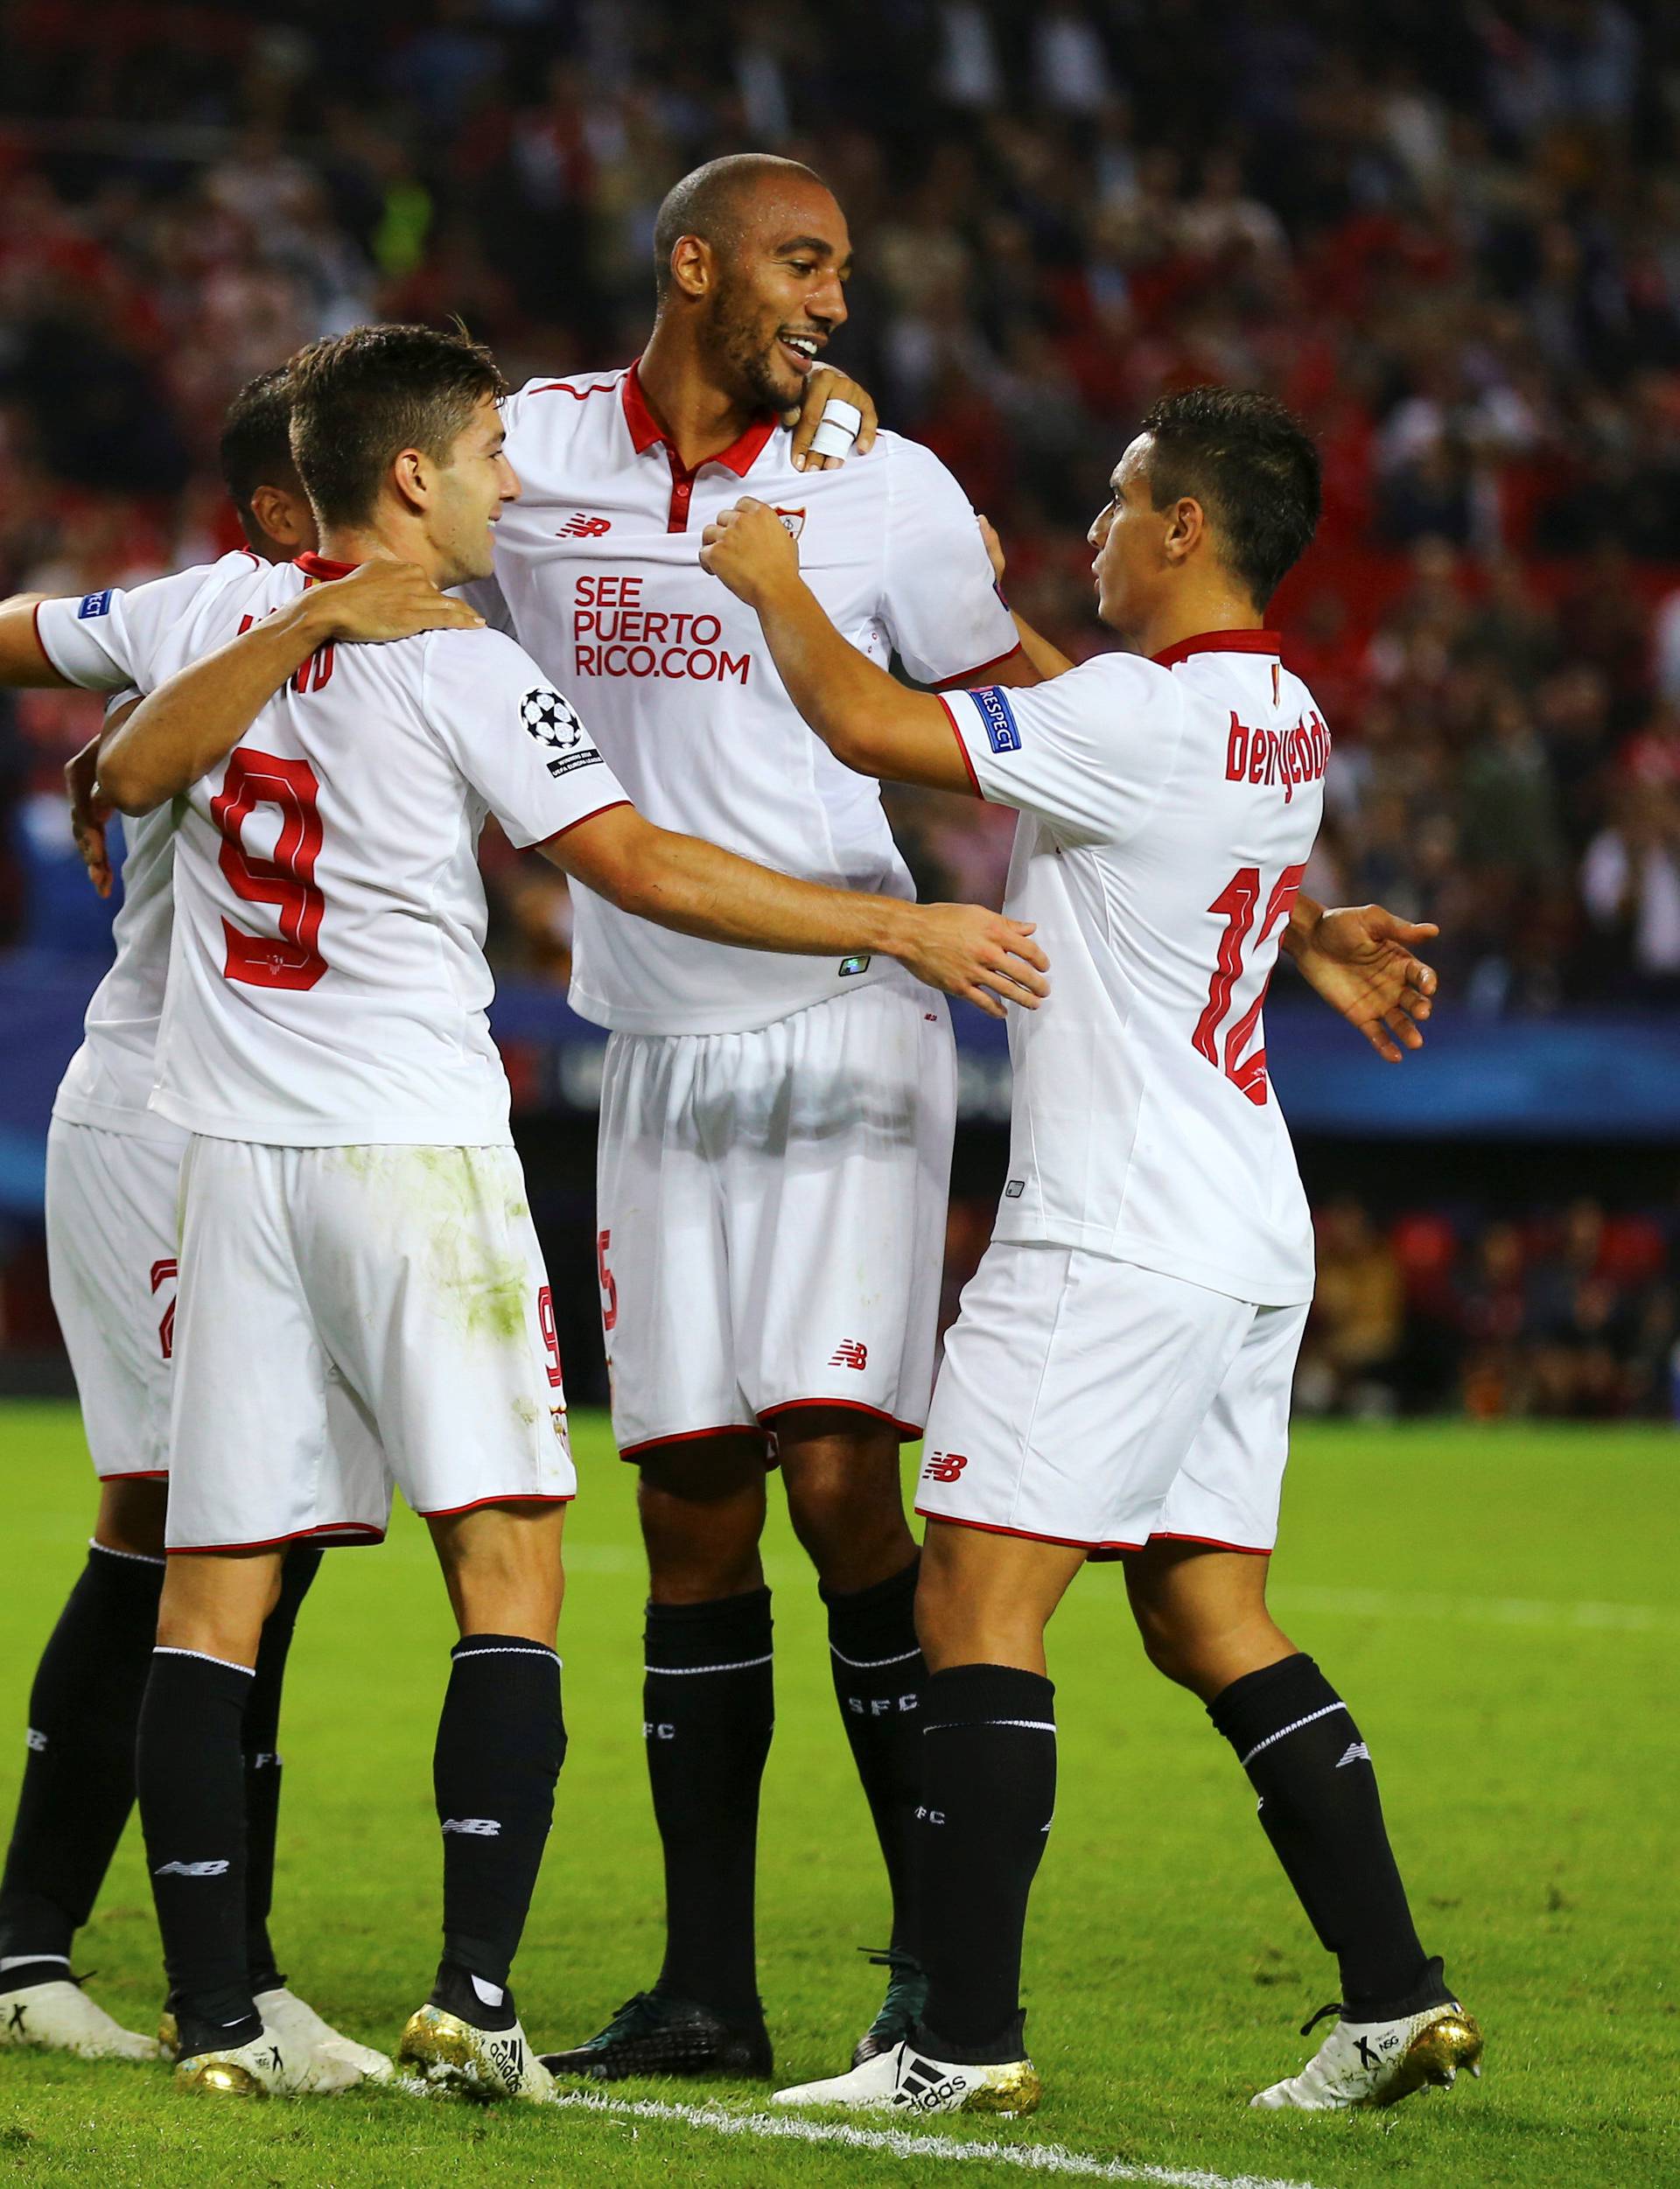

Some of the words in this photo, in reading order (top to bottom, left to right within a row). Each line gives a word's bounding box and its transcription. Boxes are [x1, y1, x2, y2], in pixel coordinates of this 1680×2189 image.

[574, 576, 643, 607] SEE
[574, 611, 721, 646] PUERTO
[575, 645, 751, 685] RICO.COM
[980, 690, 1014, 750] RESPECT
[210, 746, 329, 990] 9
[538, 1285, 562, 1388] 9
[490, 2043, 522, 2095] adidas
